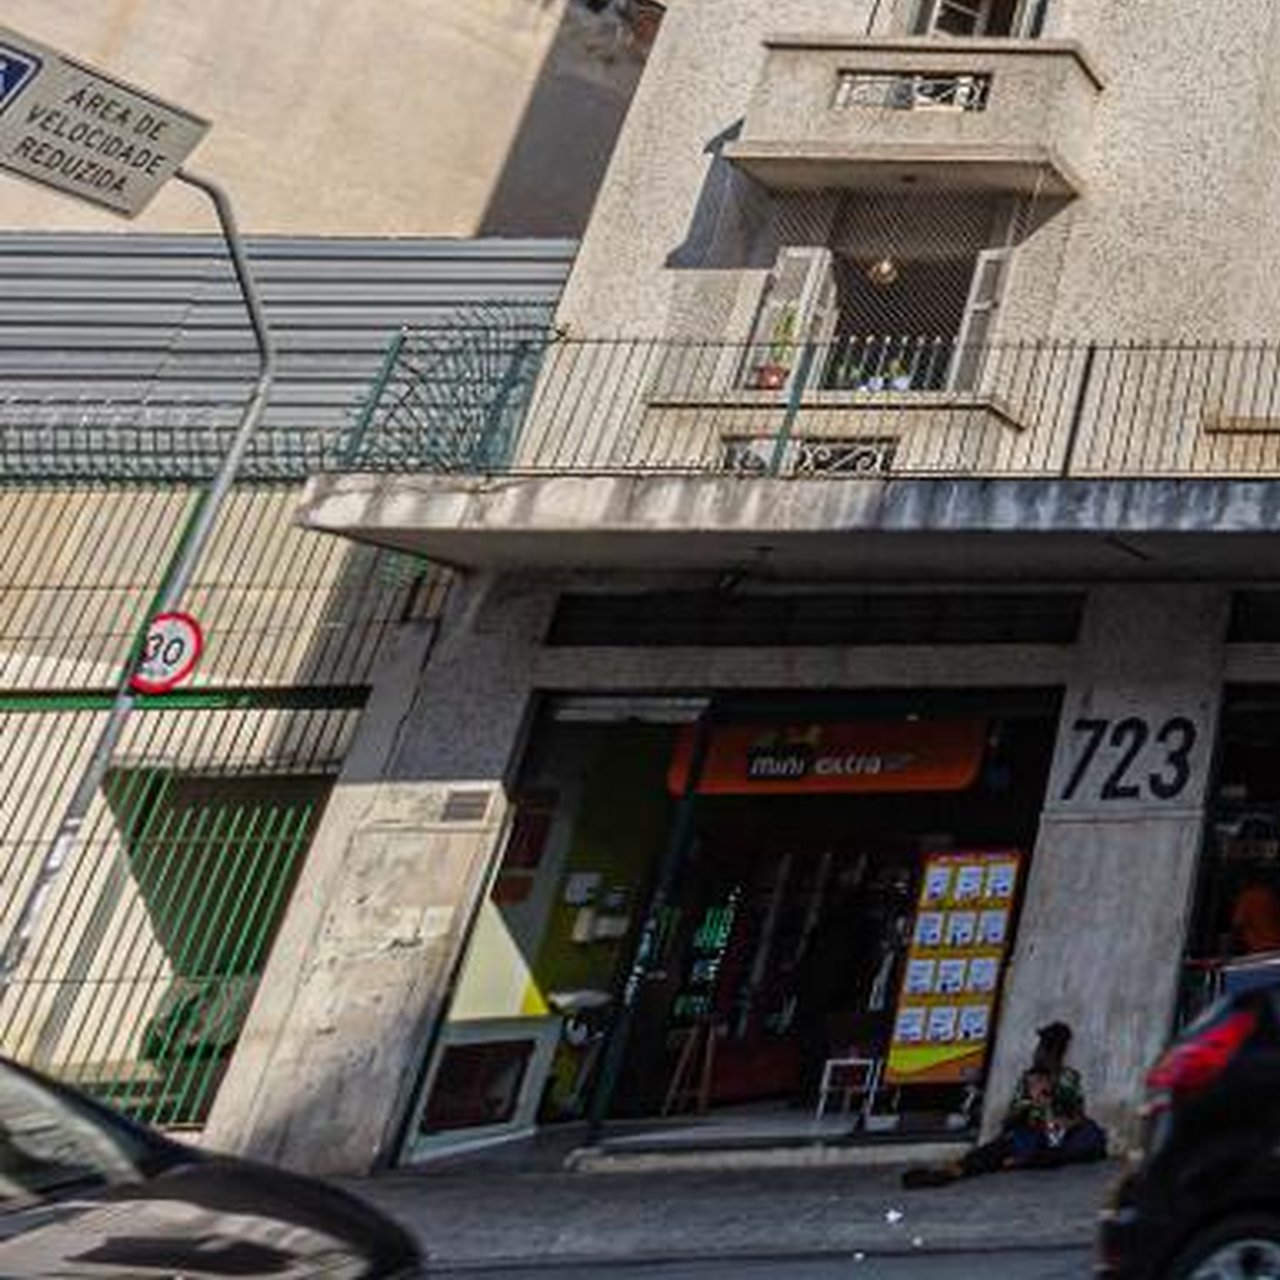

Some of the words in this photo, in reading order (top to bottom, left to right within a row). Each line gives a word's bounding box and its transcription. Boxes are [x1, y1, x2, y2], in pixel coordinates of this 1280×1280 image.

[27, 103, 168, 177] VELOCIDADE
[64, 81, 132, 127] ÁREA
[134, 113, 169, 141] DE
[14, 136, 129, 194] REDUZIDA
[142, 633, 184, 666] 30
[1060, 716, 1198, 800] 723
